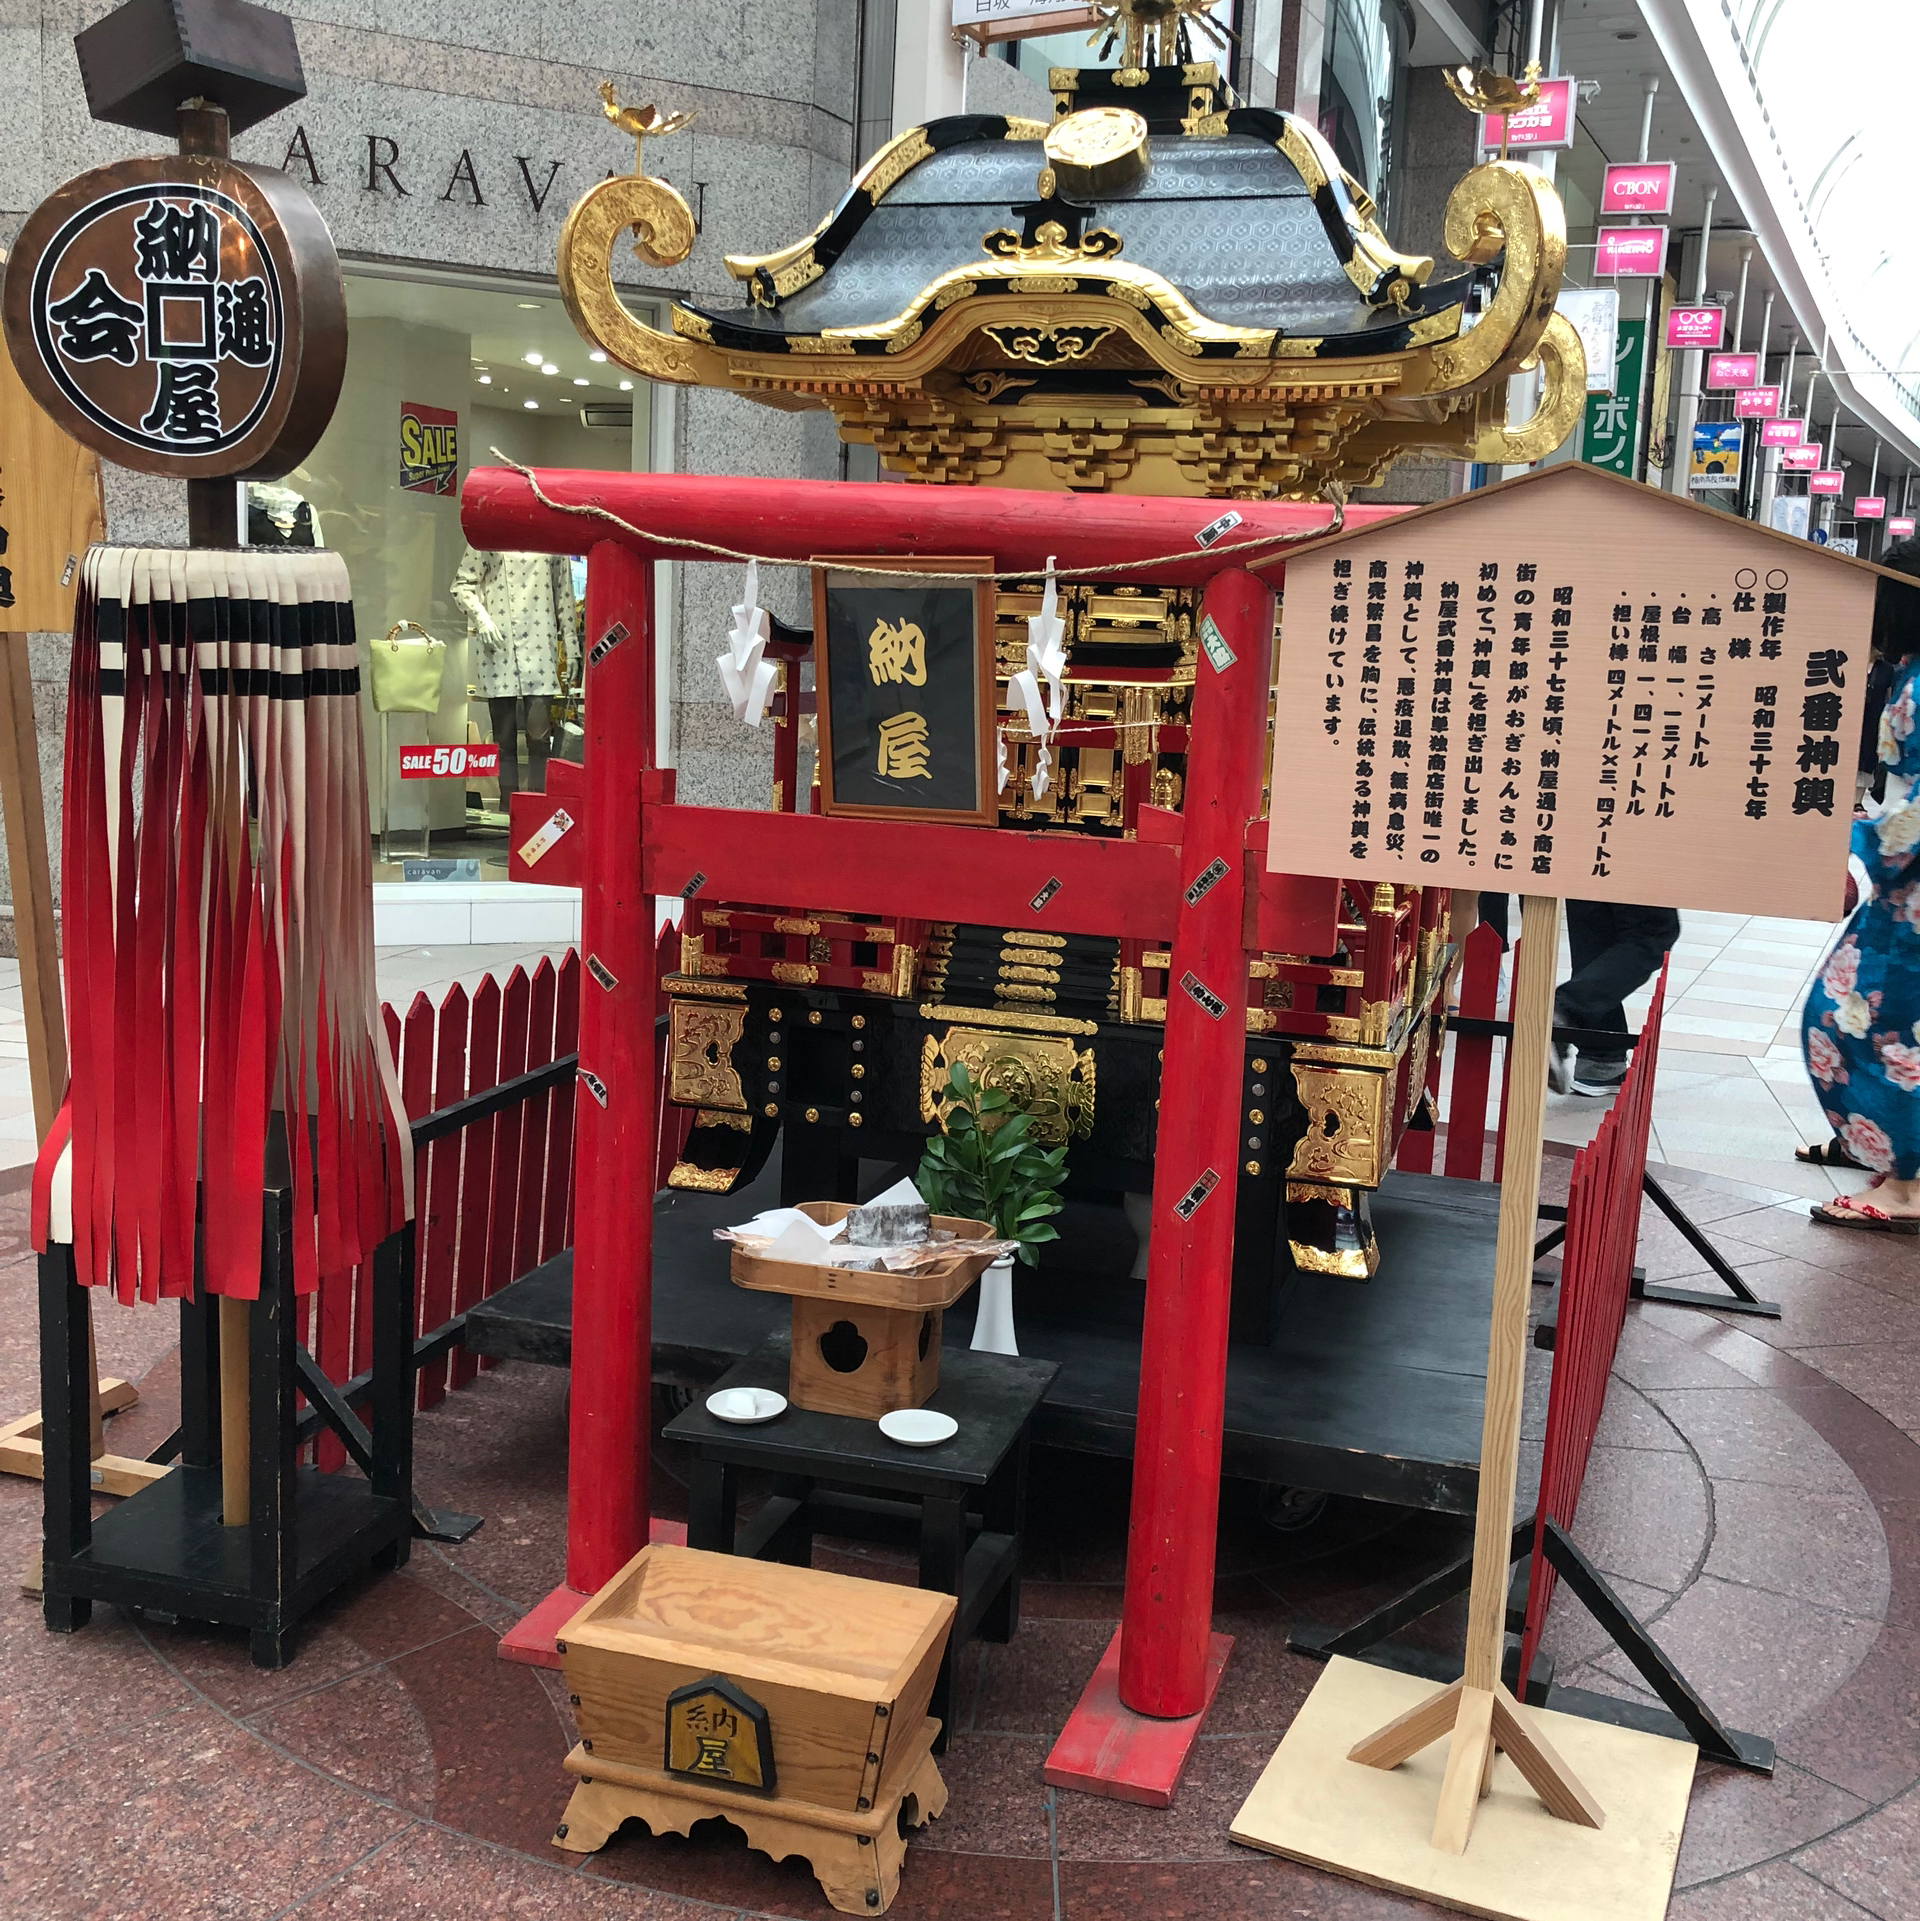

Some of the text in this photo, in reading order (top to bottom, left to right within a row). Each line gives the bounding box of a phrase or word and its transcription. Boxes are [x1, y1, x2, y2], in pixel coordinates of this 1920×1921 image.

[402, 418, 457, 467] SALE
[1323, 558, 1352, 747] 担ぎ続けています。
[401, 755, 432, 770] SALE
[1743, 685, 1779, 821] 昭和三十七年
[407, 868, 442, 876] caravan
[685, 1703, 739, 1776] 納屋
